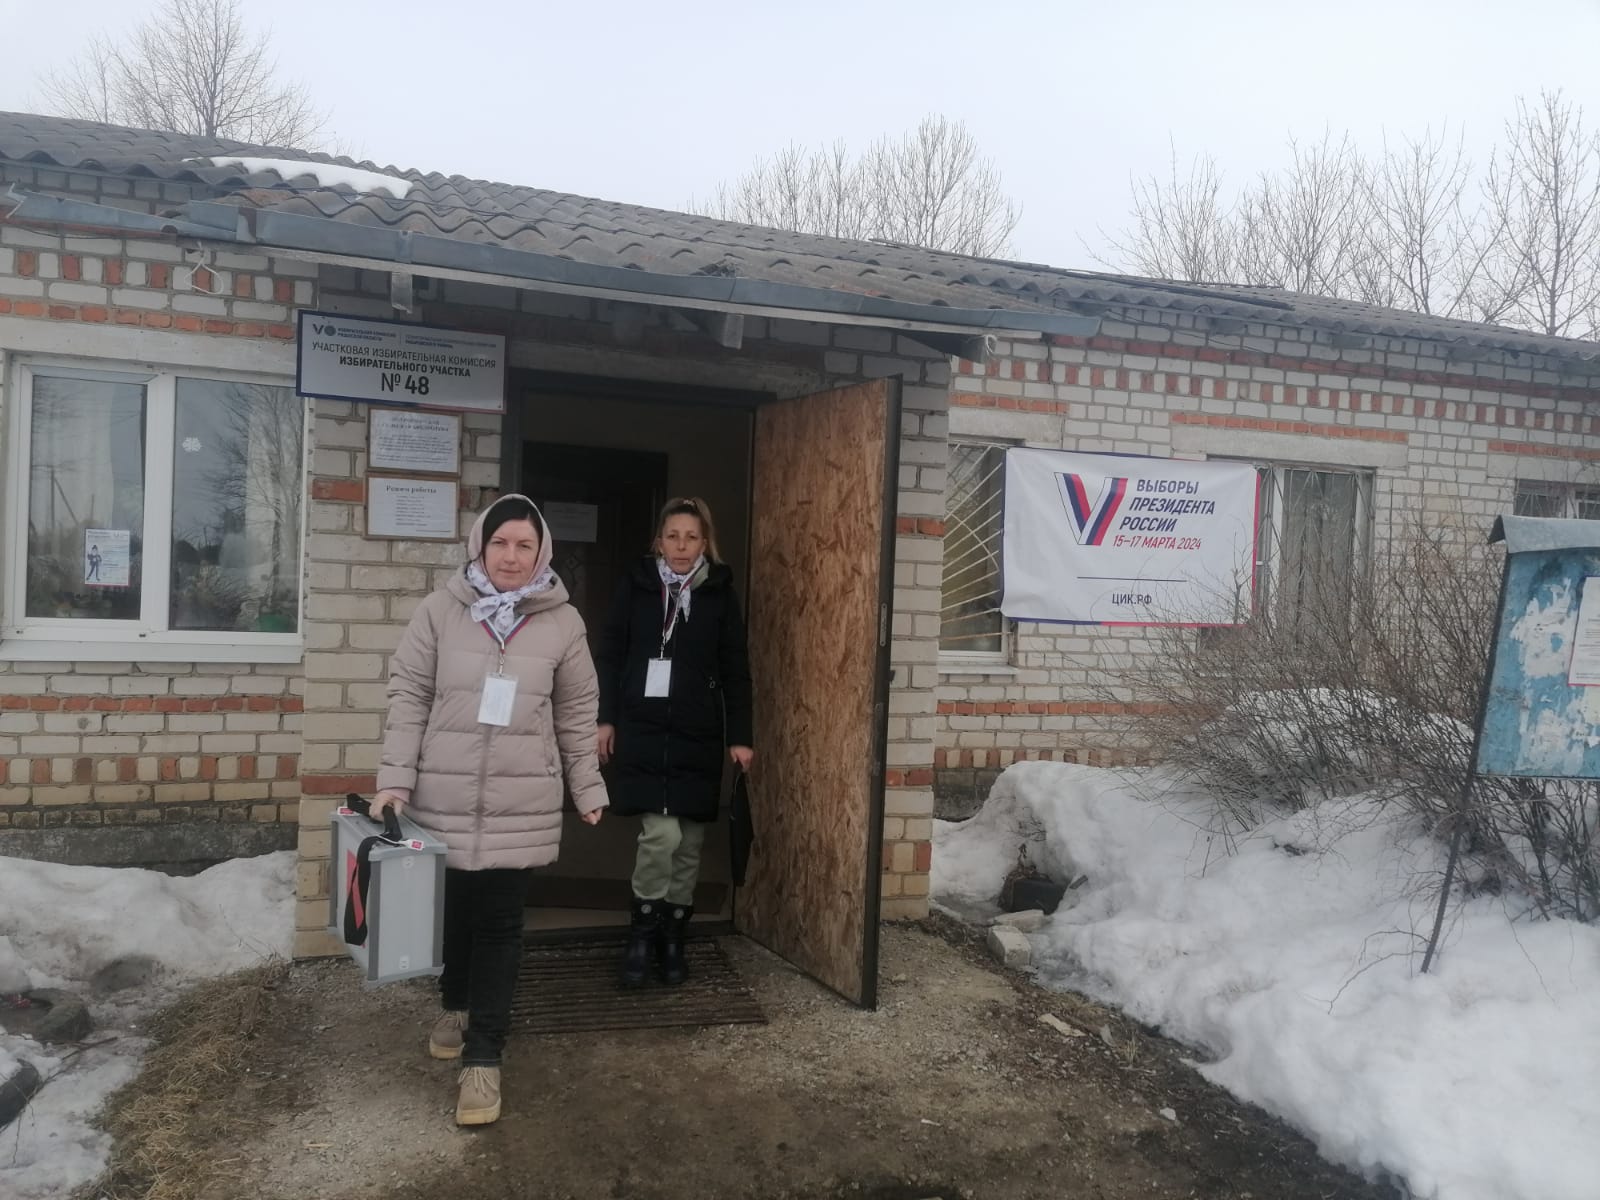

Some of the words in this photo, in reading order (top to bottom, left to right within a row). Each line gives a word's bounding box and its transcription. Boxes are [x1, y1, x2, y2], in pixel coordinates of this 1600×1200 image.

[312, 341, 369, 356] УЧАСТКОВАЯ
[372, 349, 446, 364] ИЗБИРАТЕЛЬНАЯ
[449, 355, 496, 368] КОМИССИЯ
[339, 356, 427, 373] ИЗБИРАТЕЛЬНОГО
[430, 363, 470, 377] УЧАСТКА
[405, 375, 429, 395] 48
[1136, 479, 1200, 494] ВЫБОРЫ
[1129, 497, 1215, 515] ПРЕЗИДЕНТА
[1120, 516, 1177, 532] РОССИИ
[1142, 536, 1176, 549] МАРТА
[1177, 537, 1201, 550] 2024
[1112, 594, 1152, 605] ЦИК.РФ
